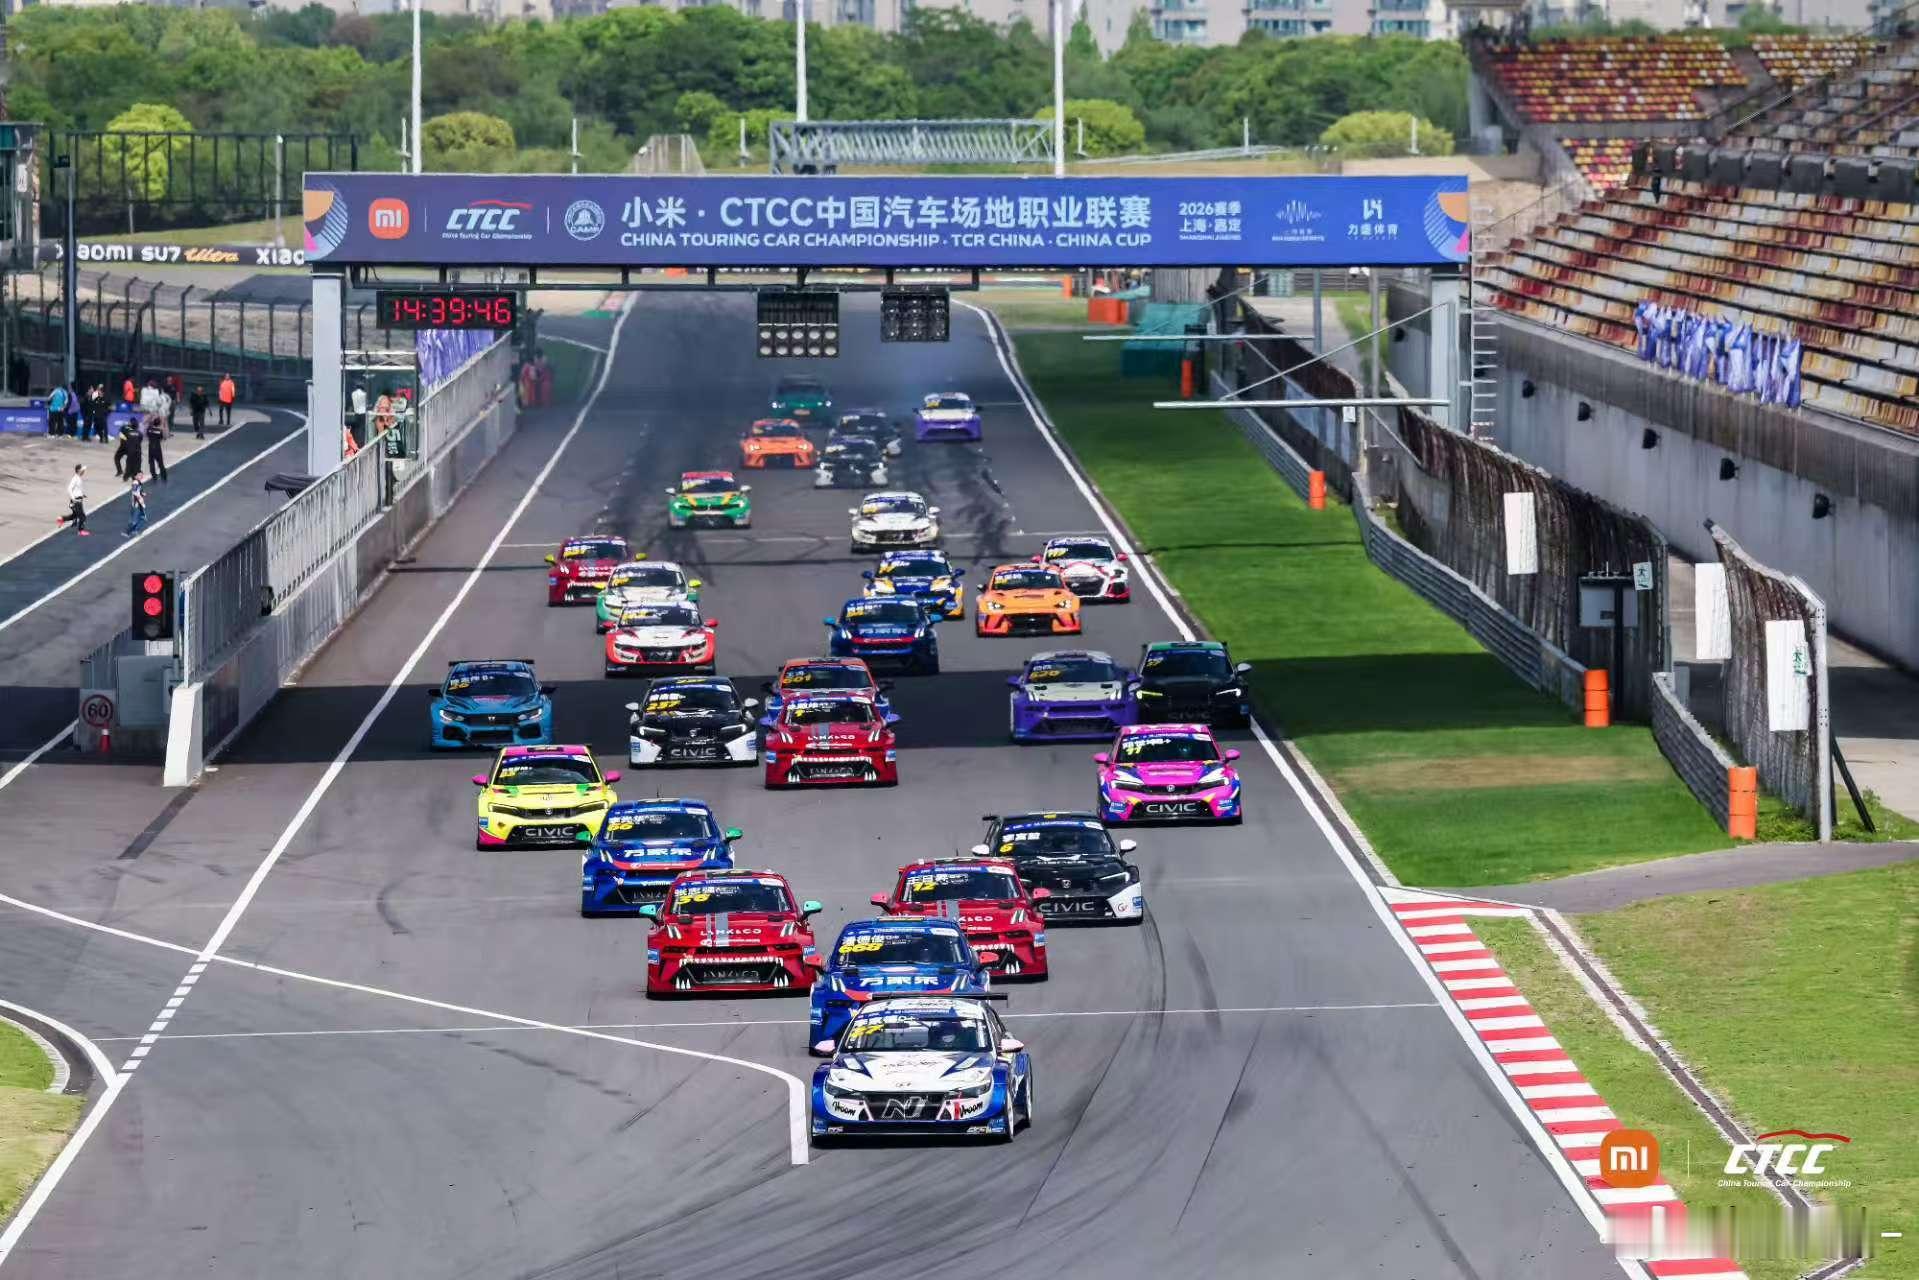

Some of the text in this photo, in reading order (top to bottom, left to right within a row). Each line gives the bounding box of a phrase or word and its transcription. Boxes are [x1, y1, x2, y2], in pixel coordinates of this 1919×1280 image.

[621, 196, 1152, 228] 小米 CTCC中国汽车场地职业联赛
[446, 208, 521, 231] CTCC
[620, 233, 1152, 247] CHINA TOURING CAR CHAMPIONSHIP TCR CHINA CHINA CUP
[141, 245, 181, 261] SU7
[393, 297, 512, 325] 14:39:46
[88, 703, 109, 718] 60
[670, 748, 717, 757] CIVIC
[1146, 803, 1197, 813] CIVIC
[525, 826, 575, 837] CIVIC
[1038, 901, 1095, 913] CIVIC
